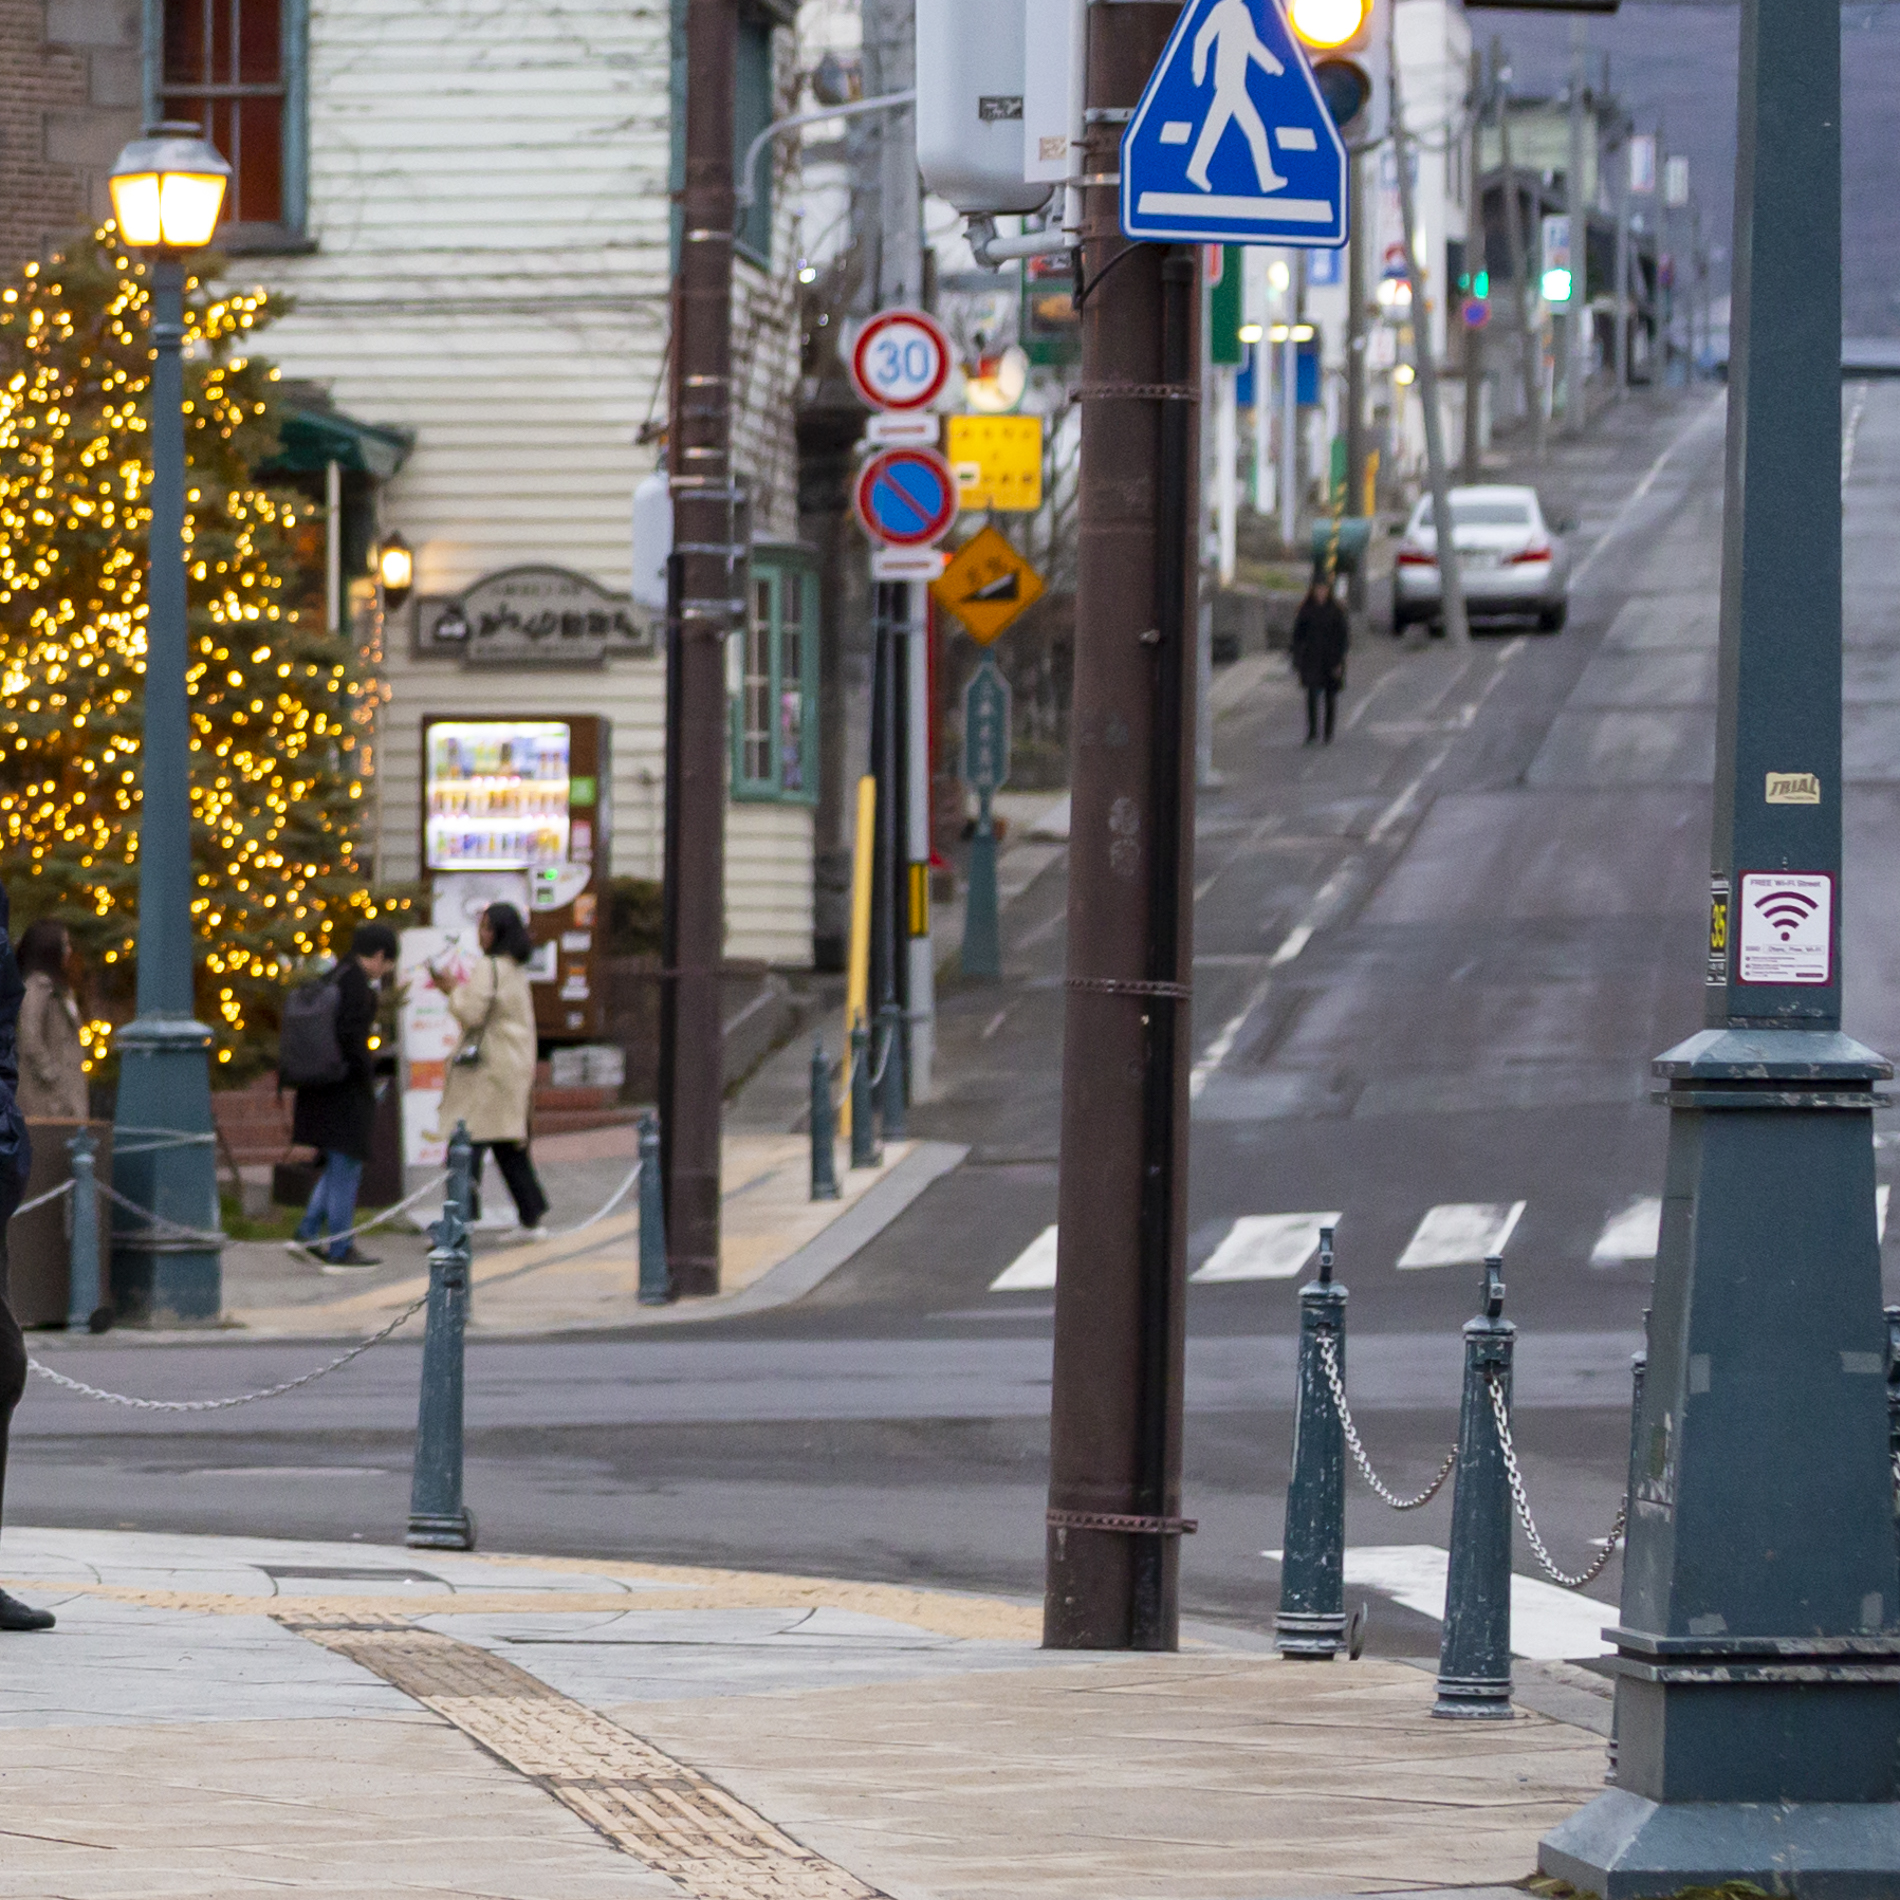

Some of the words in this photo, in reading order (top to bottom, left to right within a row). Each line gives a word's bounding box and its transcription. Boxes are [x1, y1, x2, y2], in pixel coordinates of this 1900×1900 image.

[876, 339, 931, 385] 30
[1769, 775, 1817, 796] TRIAL
[1750, 879, 1772, 887] FREE
[1774, 879, 1796, 887] Wi-Fi
[1797, 879, 1822, 888] Street
[1711, 903, 1726, 948] 35
